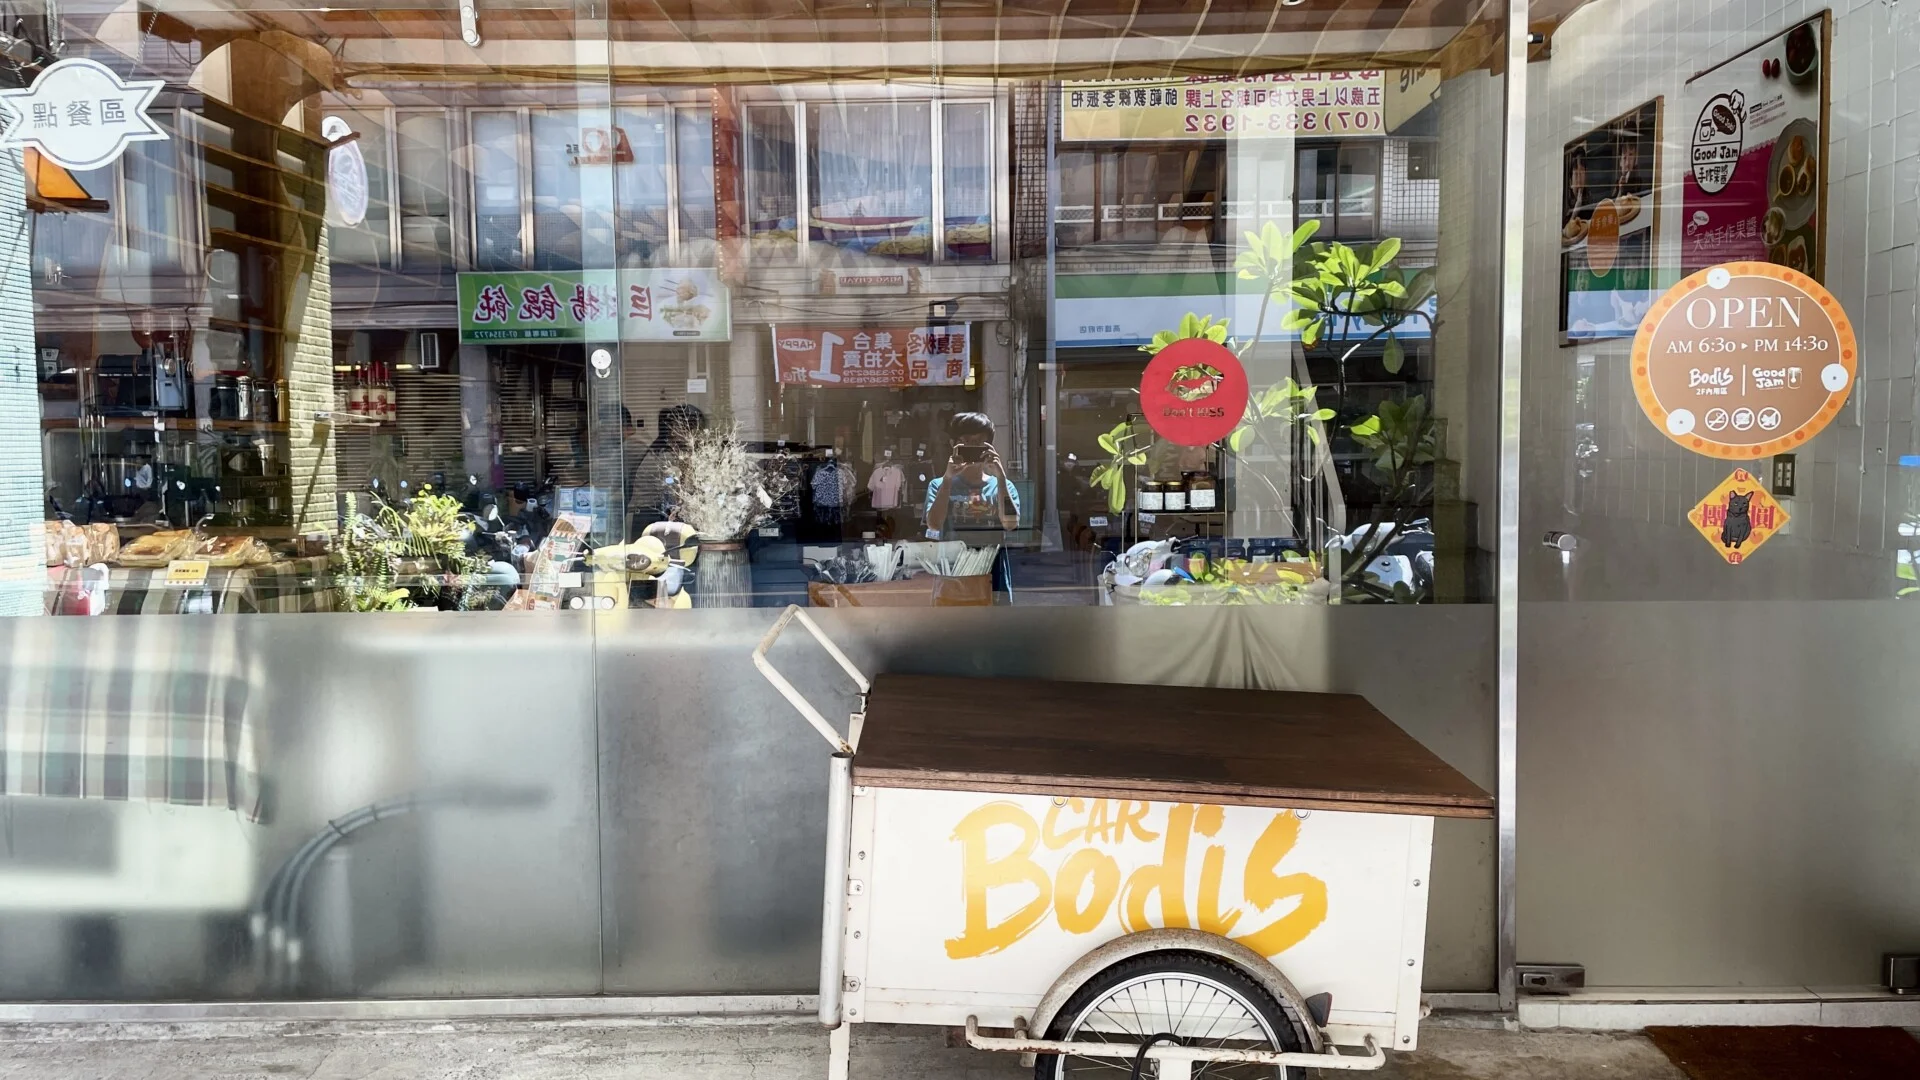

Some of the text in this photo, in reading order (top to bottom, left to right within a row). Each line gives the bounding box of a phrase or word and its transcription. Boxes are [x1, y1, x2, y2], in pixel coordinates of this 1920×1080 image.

[32, 98, 127, 129] 點餐區
[1693, 146, 1739, 161] Good Jam
[1698, 164, 1729, 184] 手作果醬
[1692, 216, 1758, 252] 天然手作果醬
[1686, 296, 1805, 330] OPEN
[1666, 336, 1828, 354] AM 6:30 PM 14:30
[1688, 365, 1734, 389] Bodis
[1752, 367, 1786, 378] Good
[1755, 377, 1784, 389] Jam
[1040, 797, 1160, 851] CAR
[944, 798, 1329, 960] Bodis
